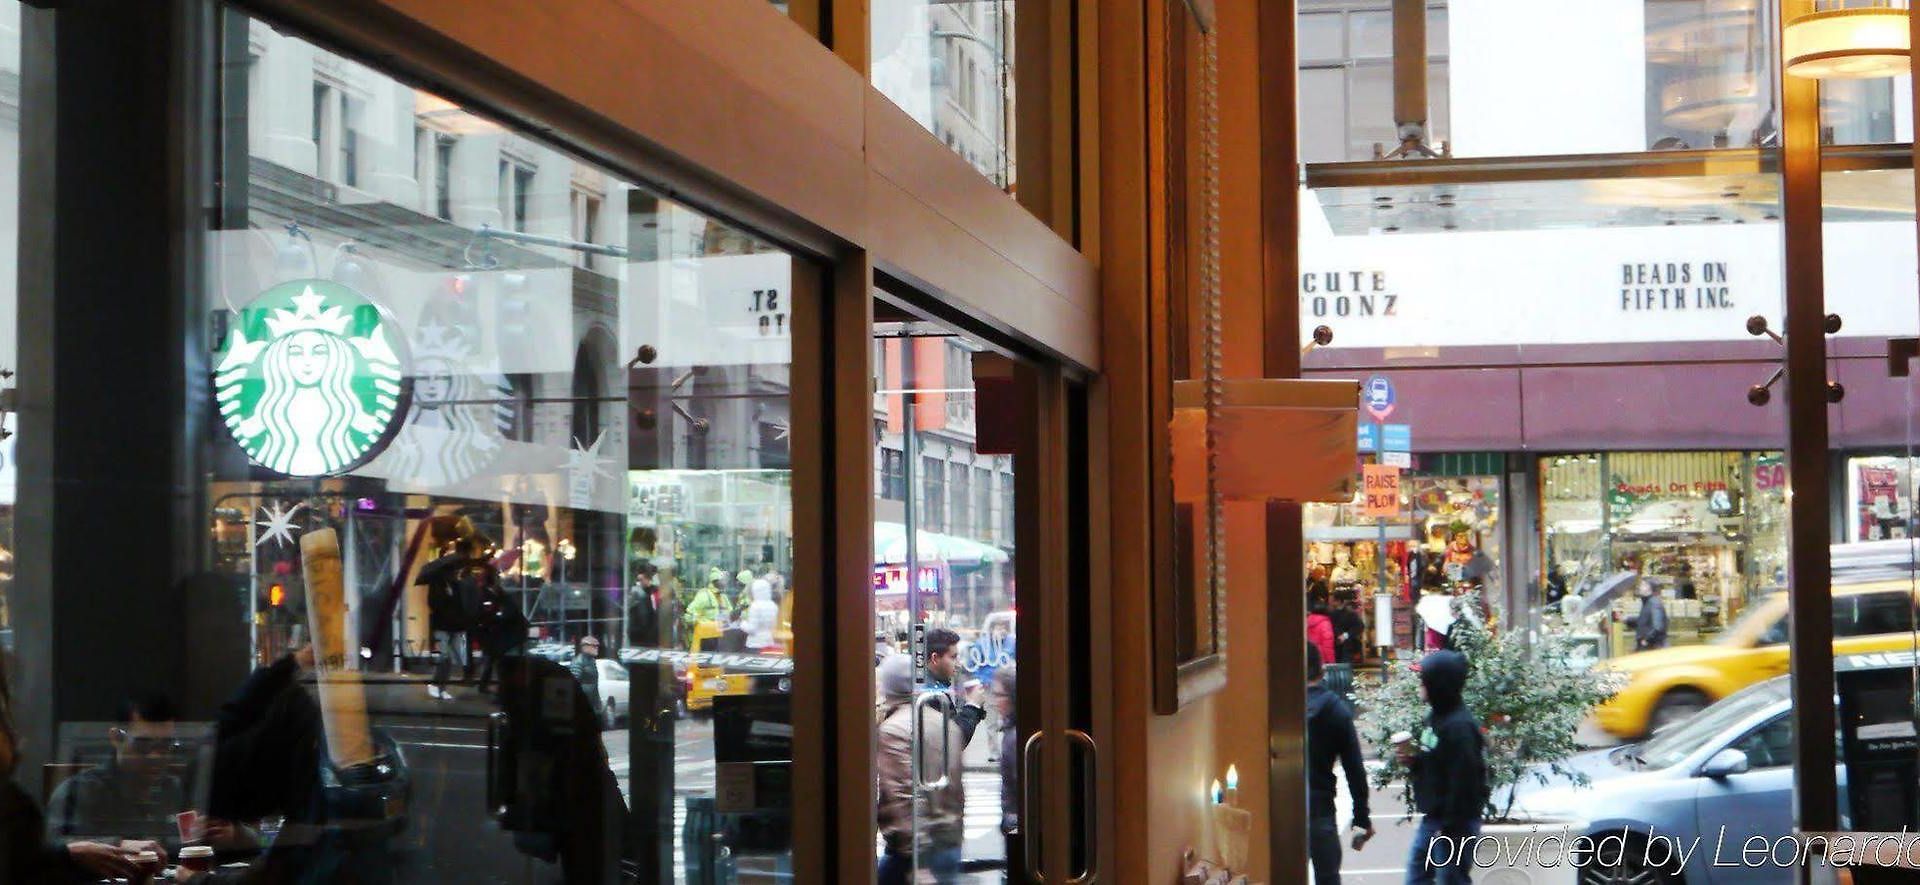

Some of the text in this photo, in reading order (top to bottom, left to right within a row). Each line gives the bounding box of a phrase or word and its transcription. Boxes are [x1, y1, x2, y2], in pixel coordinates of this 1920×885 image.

[1303, 271, 1385, 293] CUTE
[1622, 261, 1728, 285] BEADS ON
[1300, 294, 1398, 317] OONZ
[1621, 286, 1735, 310] FIFTH INC.
[1366, 475, 1396, 489] RAISE
[1669, 481, 1688, 493] On
[1694, 480, 1727, 491] Fifth
[1367, 493, 1396, 508] PLOW
